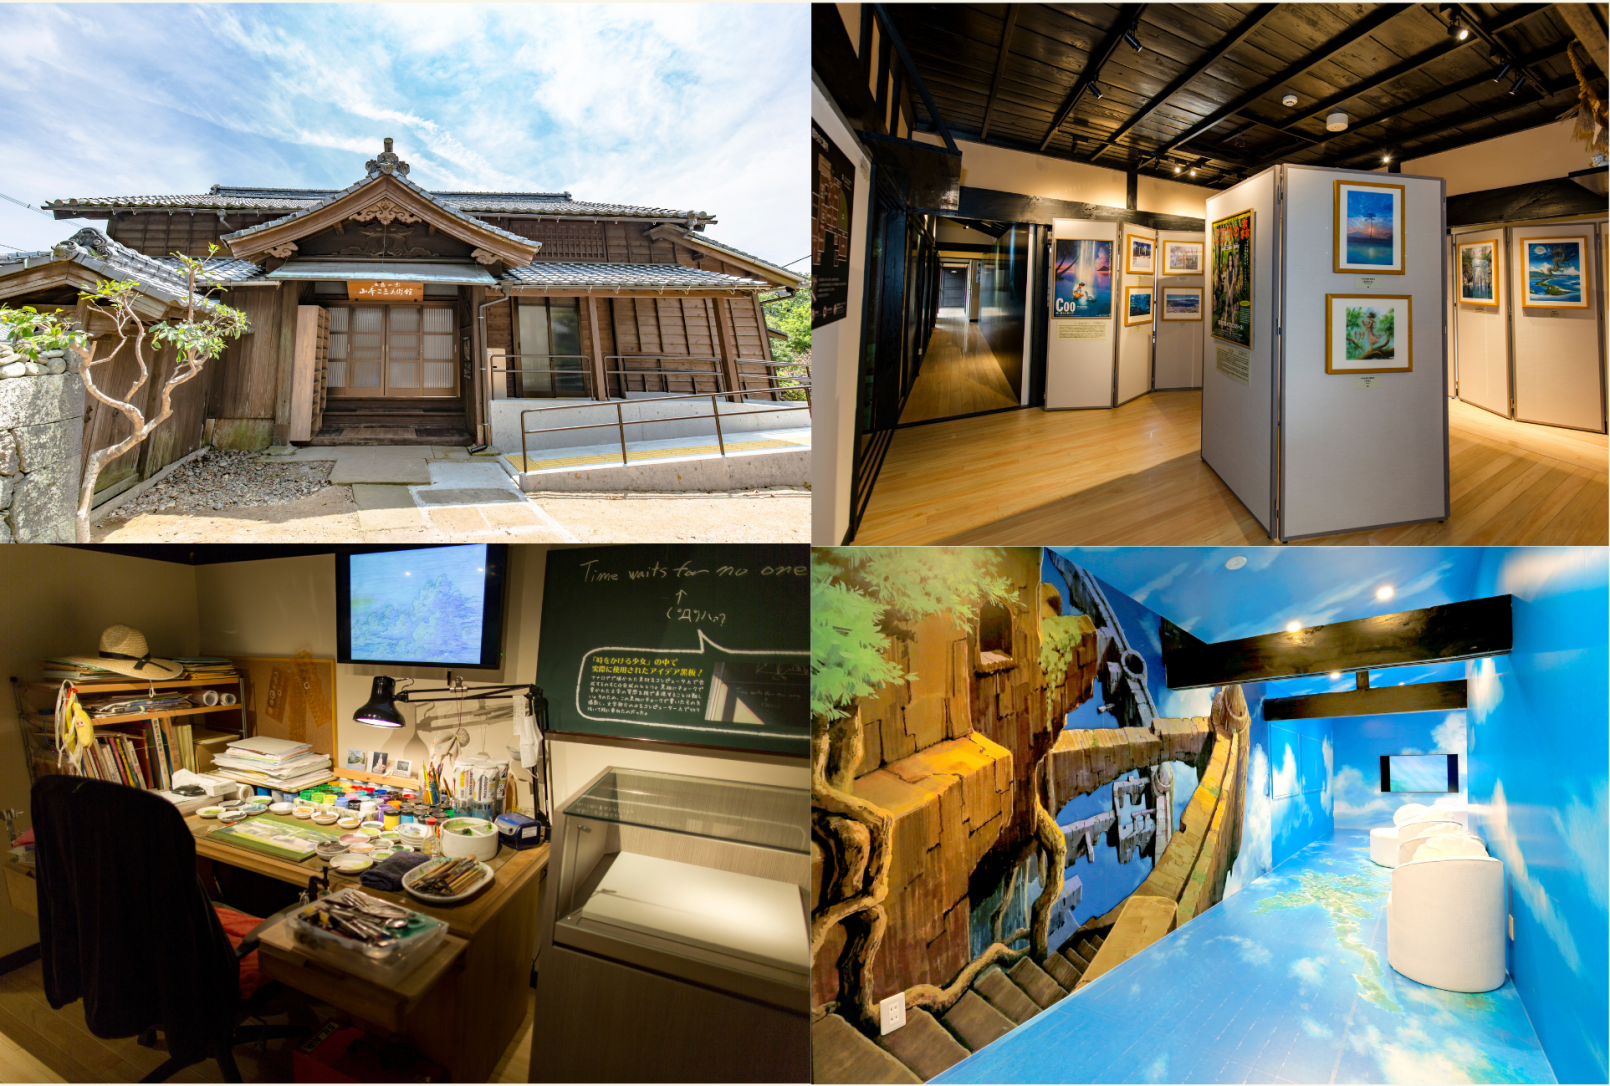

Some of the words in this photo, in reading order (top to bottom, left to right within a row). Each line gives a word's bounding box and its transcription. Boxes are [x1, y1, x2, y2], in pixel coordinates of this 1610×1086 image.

[359, 287, 413, 296] 山本二三美術館
[580, 559, 619, 582] Time
[628, 561, 668, 581] waits
[672, 560, 709, 578] for
[716, 565, 748, 577] no
[761, 565, 808, 577] one
